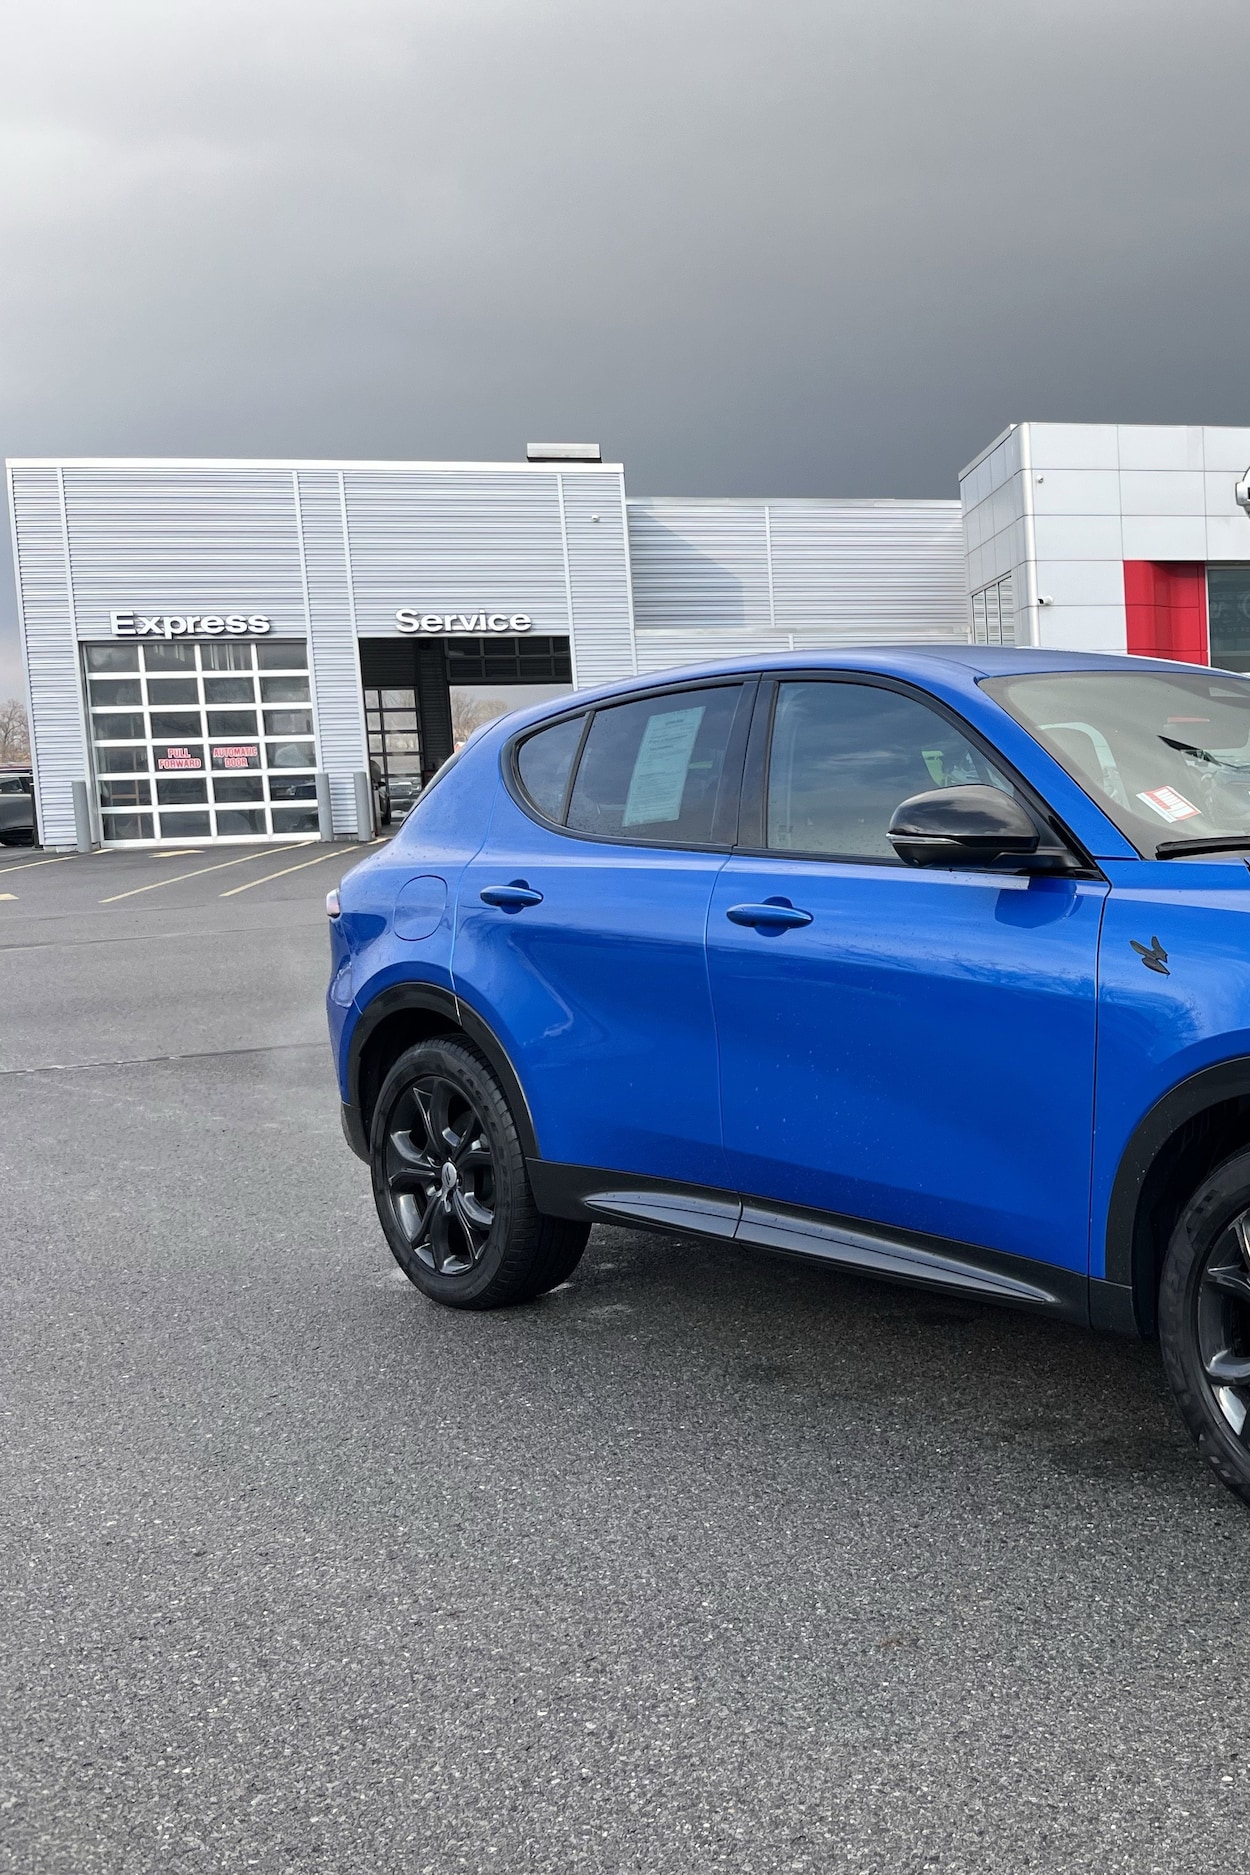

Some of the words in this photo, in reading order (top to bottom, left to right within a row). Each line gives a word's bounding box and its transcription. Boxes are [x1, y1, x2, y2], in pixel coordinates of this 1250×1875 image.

[109, 610, 271, 640] Express
[395, 608, 532, 633] Service
[167, 747, 191, 759] PULL
[213, 746, 258, 758] AUTOMATIC
[158, 757, 202, 769] FORWARD
[224, 757, 249, 768] DOOR
